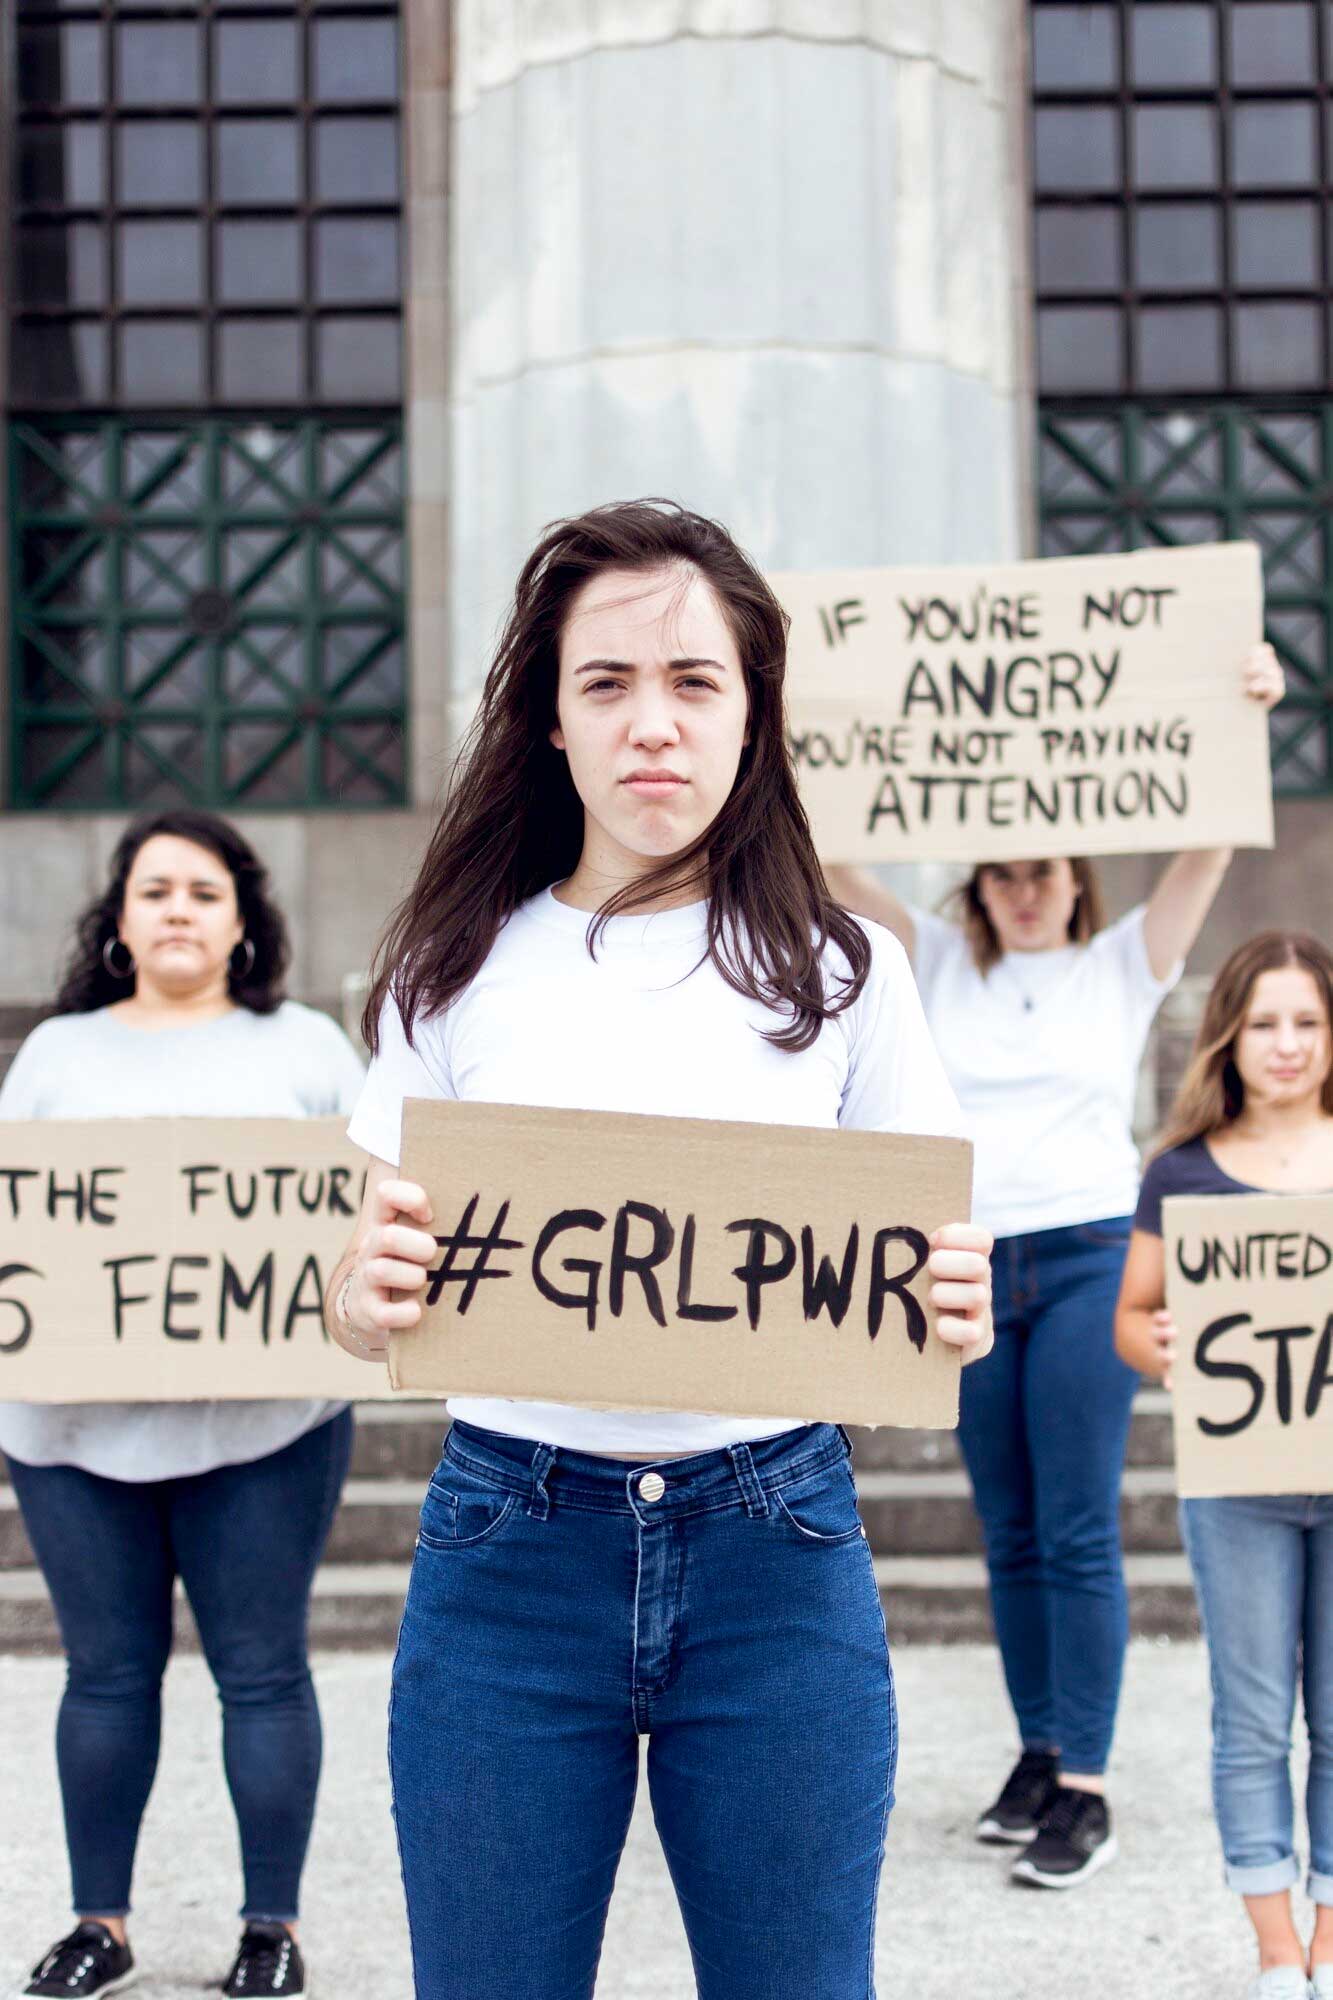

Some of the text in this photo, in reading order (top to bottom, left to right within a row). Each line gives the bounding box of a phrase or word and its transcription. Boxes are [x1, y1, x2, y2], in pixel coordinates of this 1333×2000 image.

[818, 585, 1176, 647] IF YOU'RE NOT
[902, 650, 1120, 719] ANGRY
[931, 729, 1013, 767] NOT
[1041, 718, 1192, 764] PAYING
[868, 771, 1188, 834] ATTENTION
[0, 1164, 368, 1226] THE FUTUR
[424, 1193, 930, 1354] #GRLPWR
[1177, 1233, 1333, 1285] UNITED
